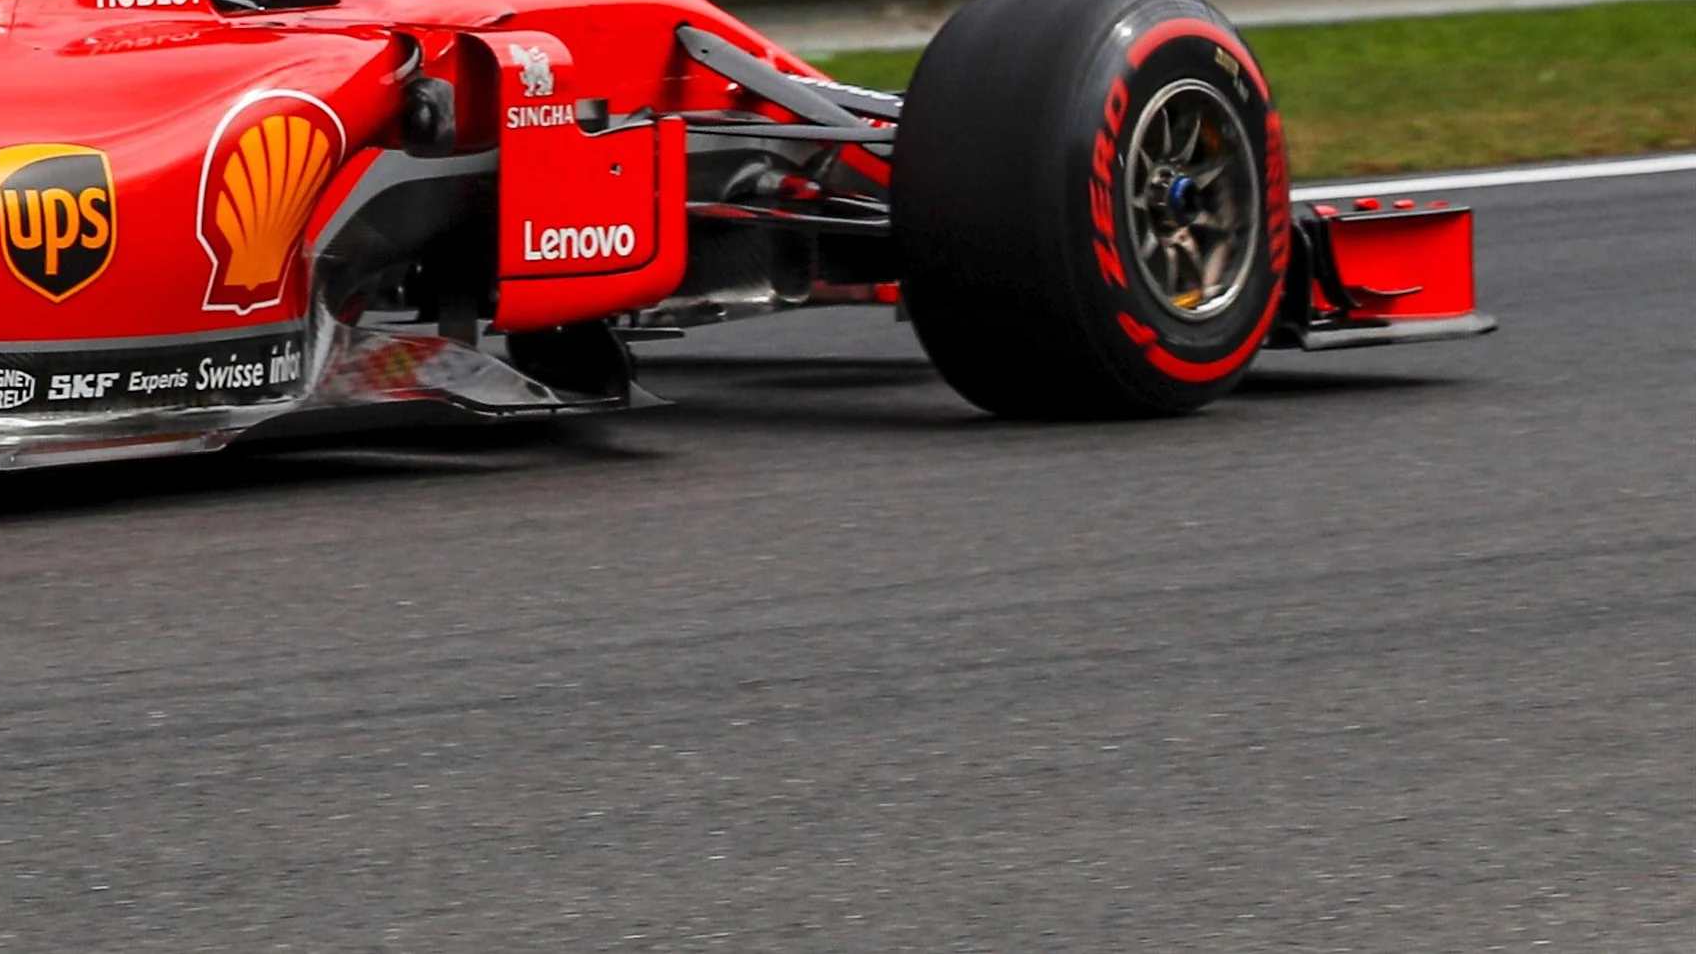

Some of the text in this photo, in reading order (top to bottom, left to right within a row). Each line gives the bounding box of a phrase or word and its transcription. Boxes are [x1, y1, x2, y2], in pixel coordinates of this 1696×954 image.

[507, 104, 575, 128] SINGHA
[524, 221, 635, 260] Lenovo
[47, 372, 121, 400] SKF
[128, 368, 189, 394] Experis
